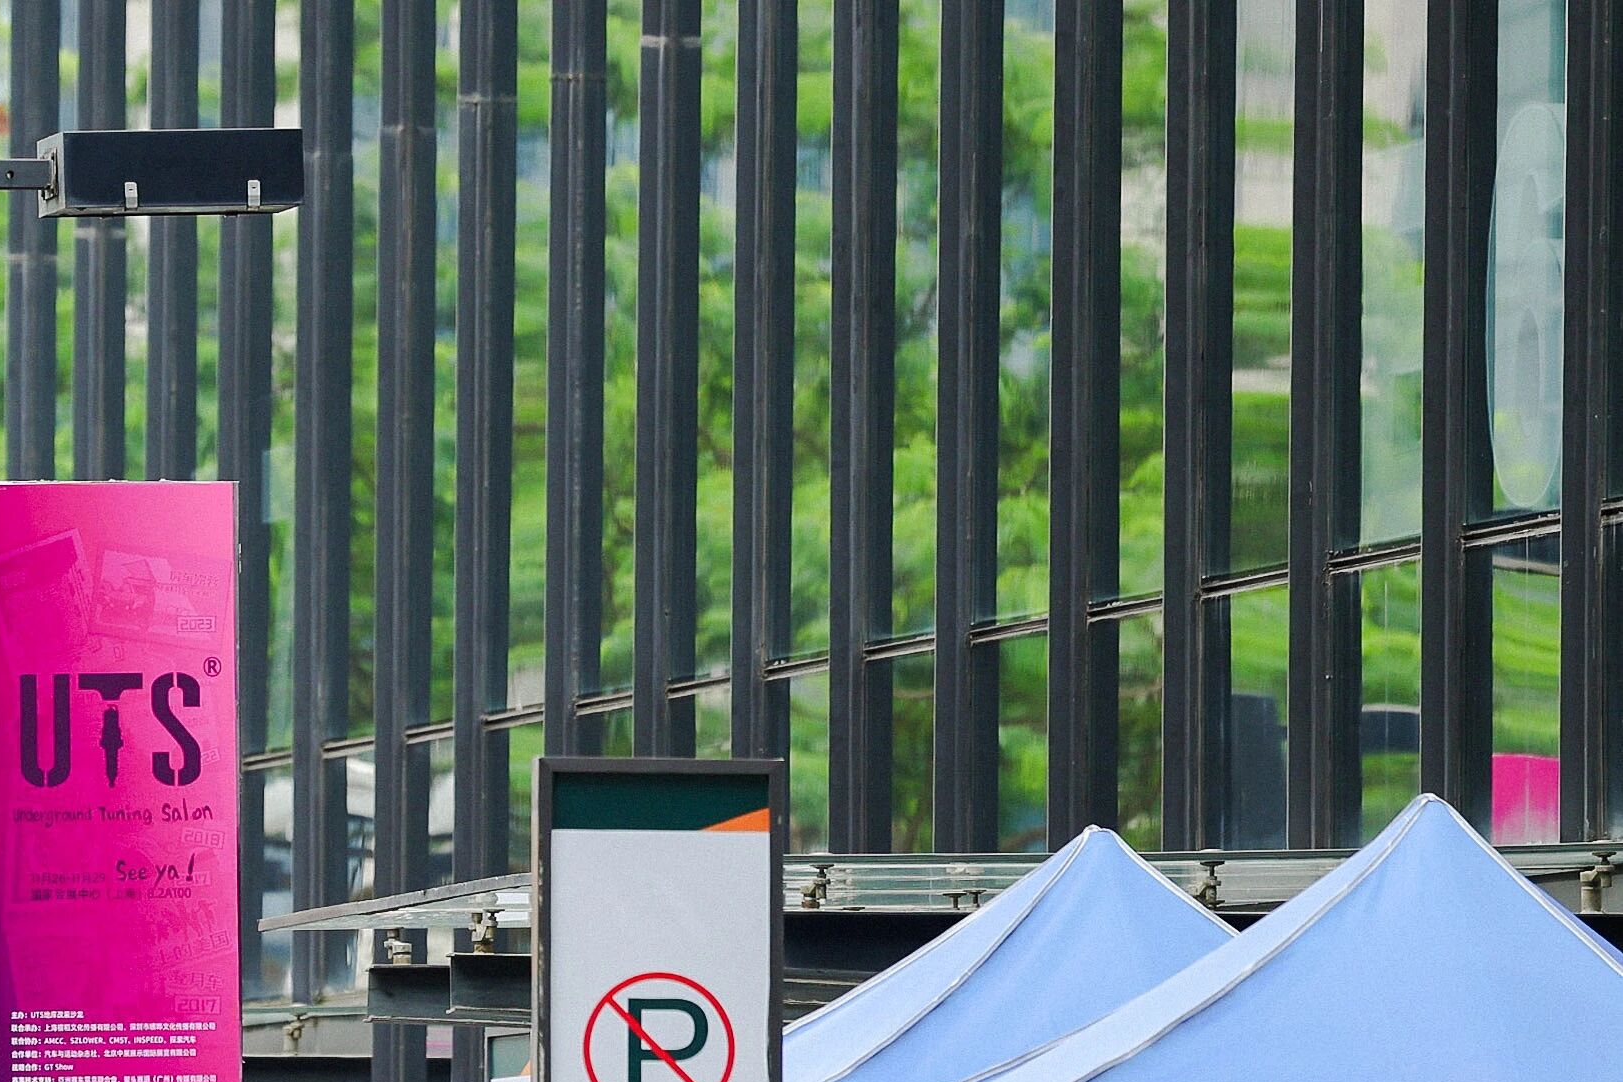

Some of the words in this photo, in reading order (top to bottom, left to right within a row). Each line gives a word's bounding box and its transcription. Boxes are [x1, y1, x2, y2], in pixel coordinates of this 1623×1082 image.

[20, 672, 201, 787] UTS
[98, 807, 152, 825] Tuning
[162, 798, 213, 821] Salon
[117, 860, 147, 880] See
